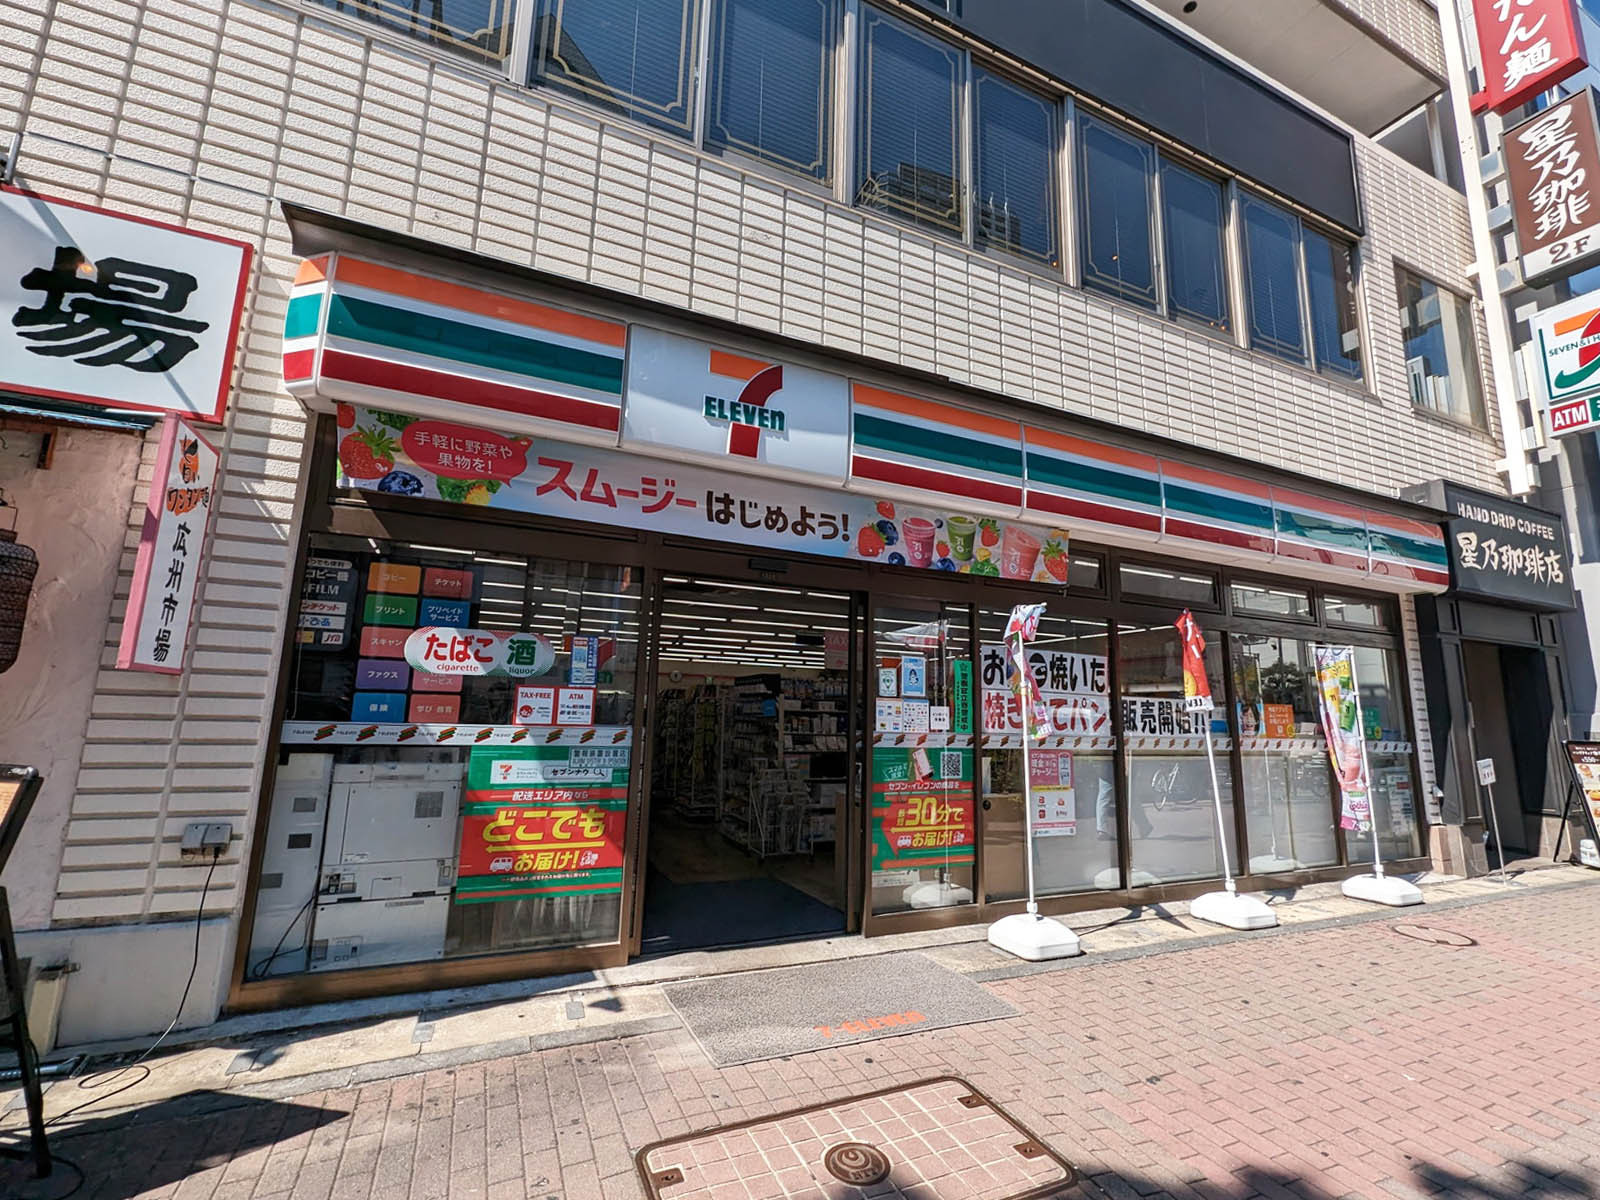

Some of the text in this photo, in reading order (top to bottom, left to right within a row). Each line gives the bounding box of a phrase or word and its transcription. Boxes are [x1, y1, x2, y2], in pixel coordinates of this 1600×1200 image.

[1548, 234, 1592, 265] 2F
[12, 246, 210, 373] 場
[1554, 404, 1587, 429] ATM
[413, 431, 513, 459] 手軽に野菜や
[536, 456, 697, 514] スムージー
[1456, 502, 1555, 541] HAND DRIP COFFEE
[1455, 531, 1564, 587] 星乃珈琲店
[382, 573, 407, 582] コピー
[434, 577, 462, 587] チケット
[153, 522, 191, 664] 広州市場
[375, 605, 406, 616] プリント
[429, 614, 460, 623] サービス
[370, 638, 403, 647] スキャン
[423, 633, 495, 663] たばこ
[506, 638, 537, 666] 酒
[367, 670, 399, 679] ファクス
[436, 662, 480, 673] cigarette
[508, 665, 536, 677] liquor
[983, 648, 1106, 692] おで焼いた
[568, 692, 585, 701] ATM
[985, 692, 1107, 733] 焼きてパン
[551, 767, 590, 777] セブンナウ
[481, 808, 606, 842] どこでも
[513, 850, 579, 872] お届け!
